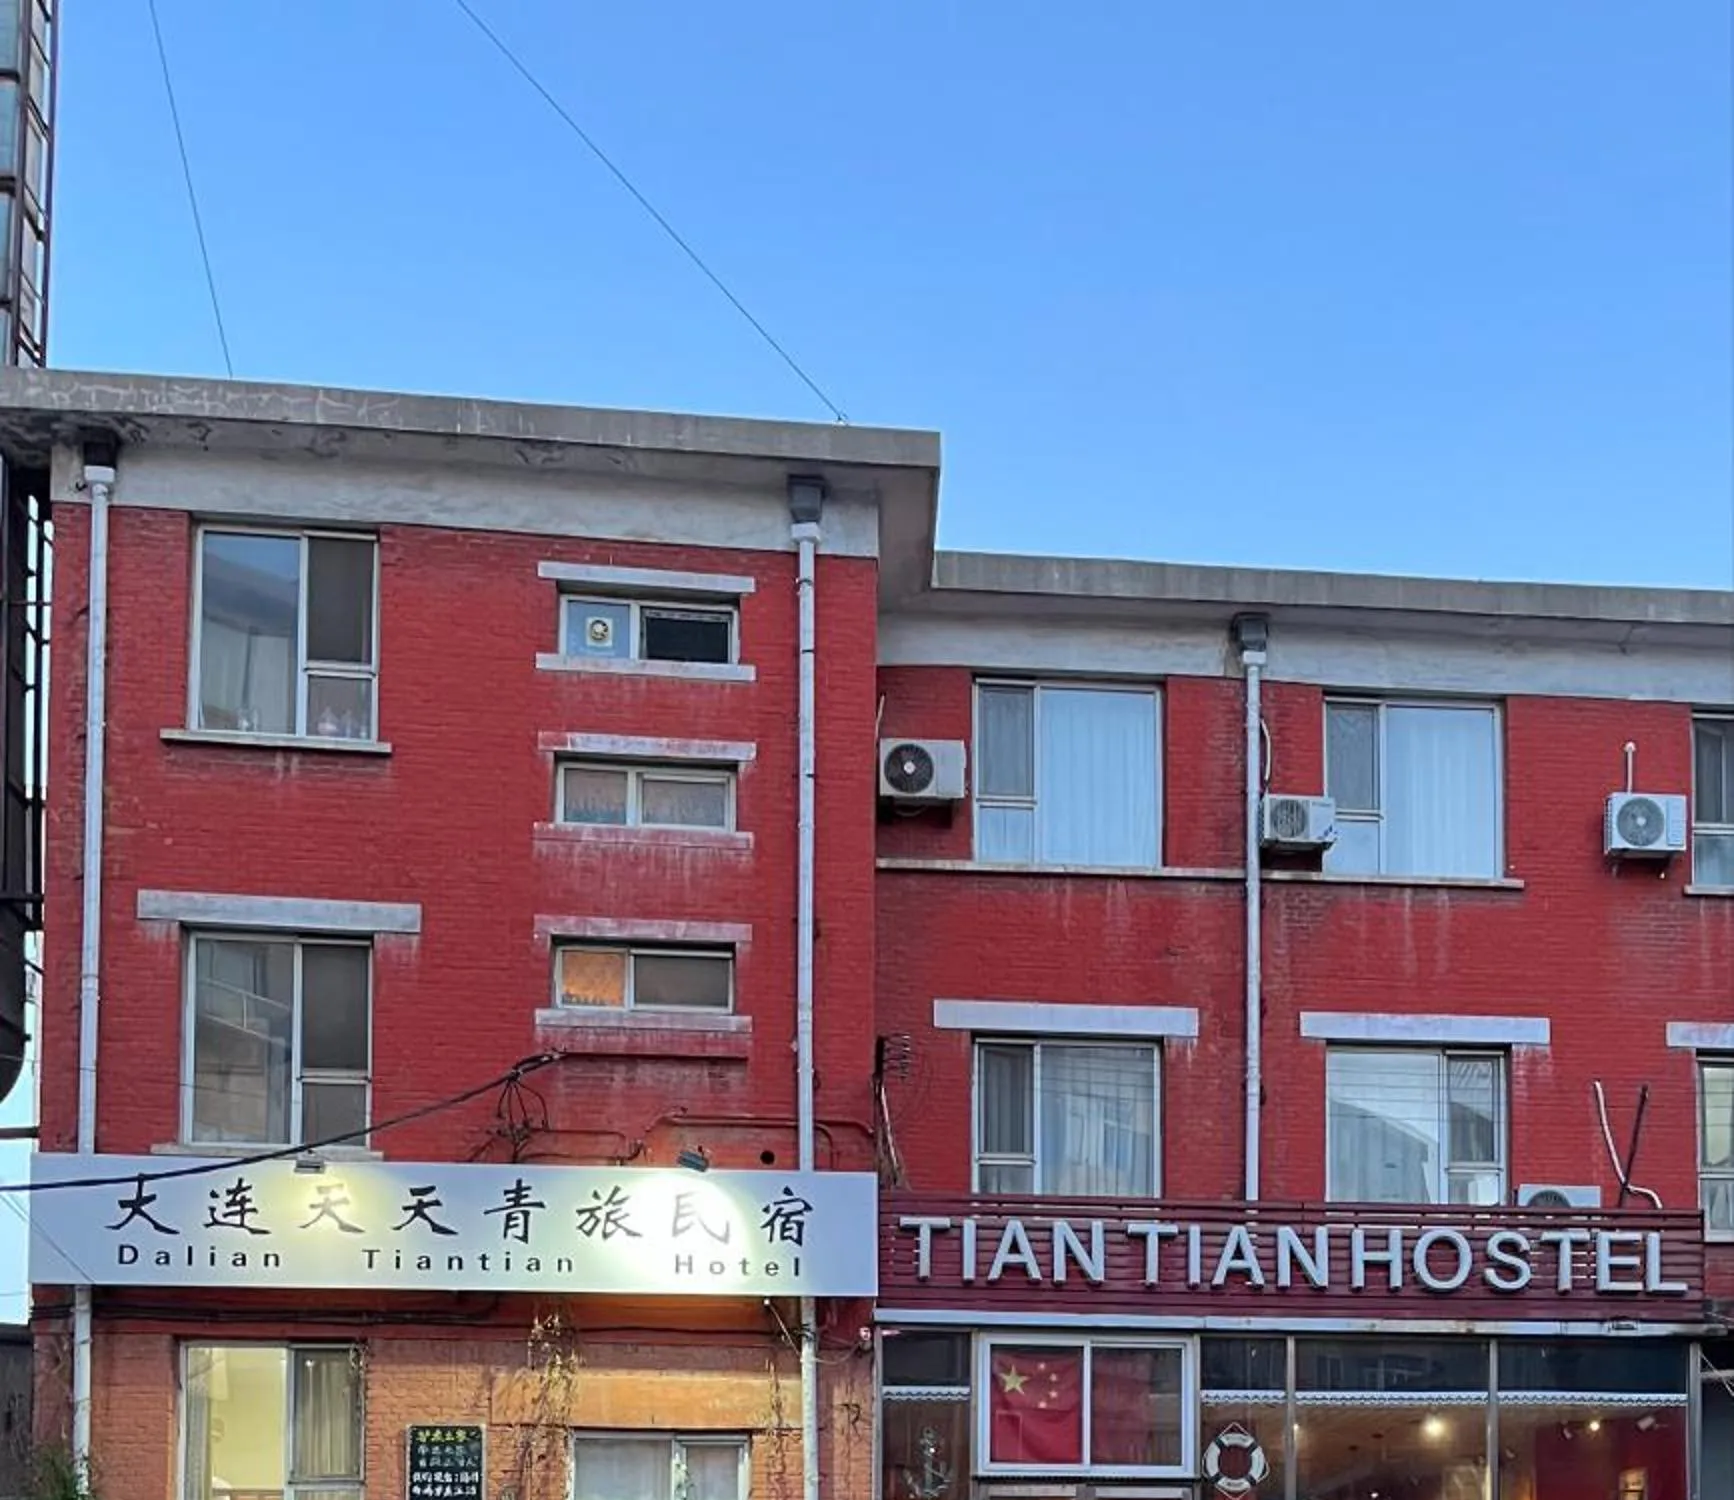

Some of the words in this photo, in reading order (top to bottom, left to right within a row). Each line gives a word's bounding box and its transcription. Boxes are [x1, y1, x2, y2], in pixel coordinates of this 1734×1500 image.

[105, 1173, 814, 1247] 大连天天青旅民宿
[117, 1245, 281, 1267] Dalian
[362, 1249, 573, 1273] Tiantian
[674, 1254, 800, 1277] Hotel
[899, 1216, 1105, 1284] TIAN
[1127, 1223, 1330, 1290] TIAN
[1351, 1227, 1689, 1294] HOSTEL
